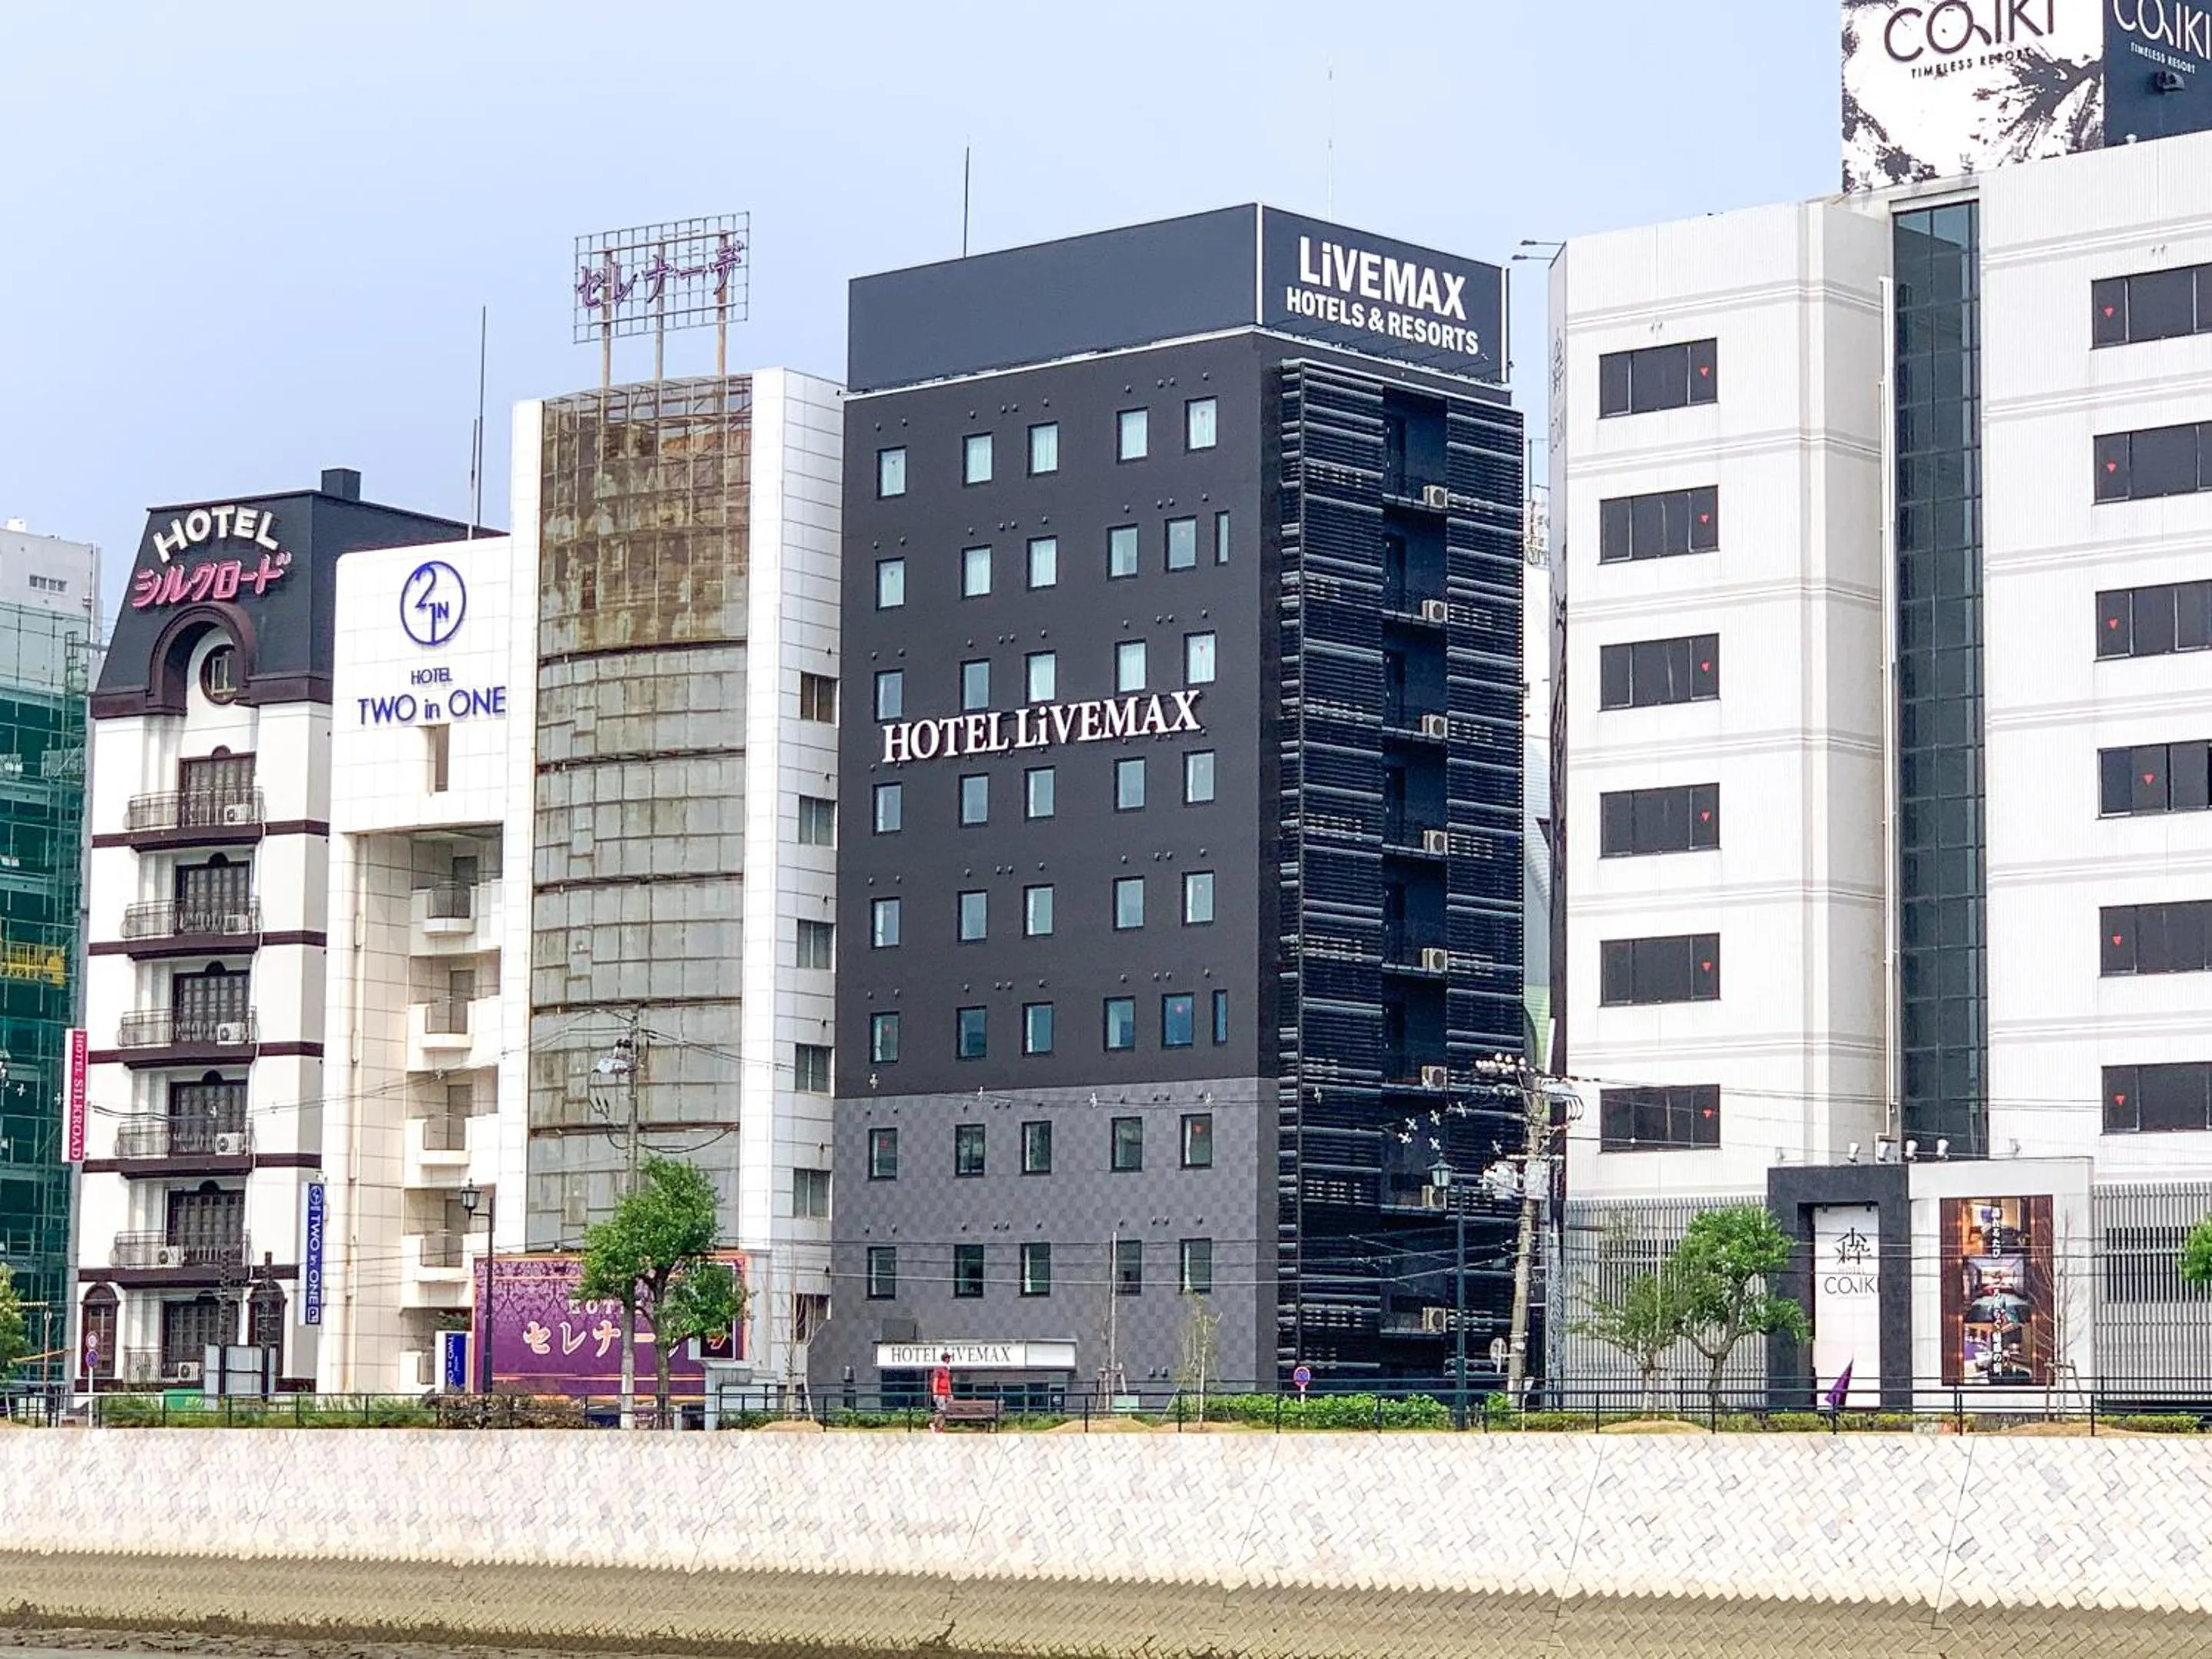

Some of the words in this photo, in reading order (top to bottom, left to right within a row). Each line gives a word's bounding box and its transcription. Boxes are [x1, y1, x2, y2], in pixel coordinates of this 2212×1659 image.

[1912, 58, 1973, 79] TIMELESS
[1980, 47, 2032, 68] RESORT
[2167, 55, 2195, 75] RESORT
[1286, 286, 1365, 329] HOTELS
[1367, 307, 1384, 334] &
[1387, 311, 1479, 355] RESORTS
[153, 505, 280, 564] HOTEL
[131, 551, 293, 608] シルクロード
[411, 667, 453, 685] HOTEL
[357, 694, 417, 725] TWO
[424, 698, 441, 720] in
[449, 686, 506, 717] ONE
[882, 711, 1010, 763] HOTEL
[75, 1035, 85, 1075] HOTEL
[71, 1078, 84, 1159] SILKROAD
[310, 1215, 321, 1251] TWO
[309, 1269, 320, 1305] ONE
[523, 1320, 680, 1358] セレナー
[891, 1346, 938, 1363] HOTEL
